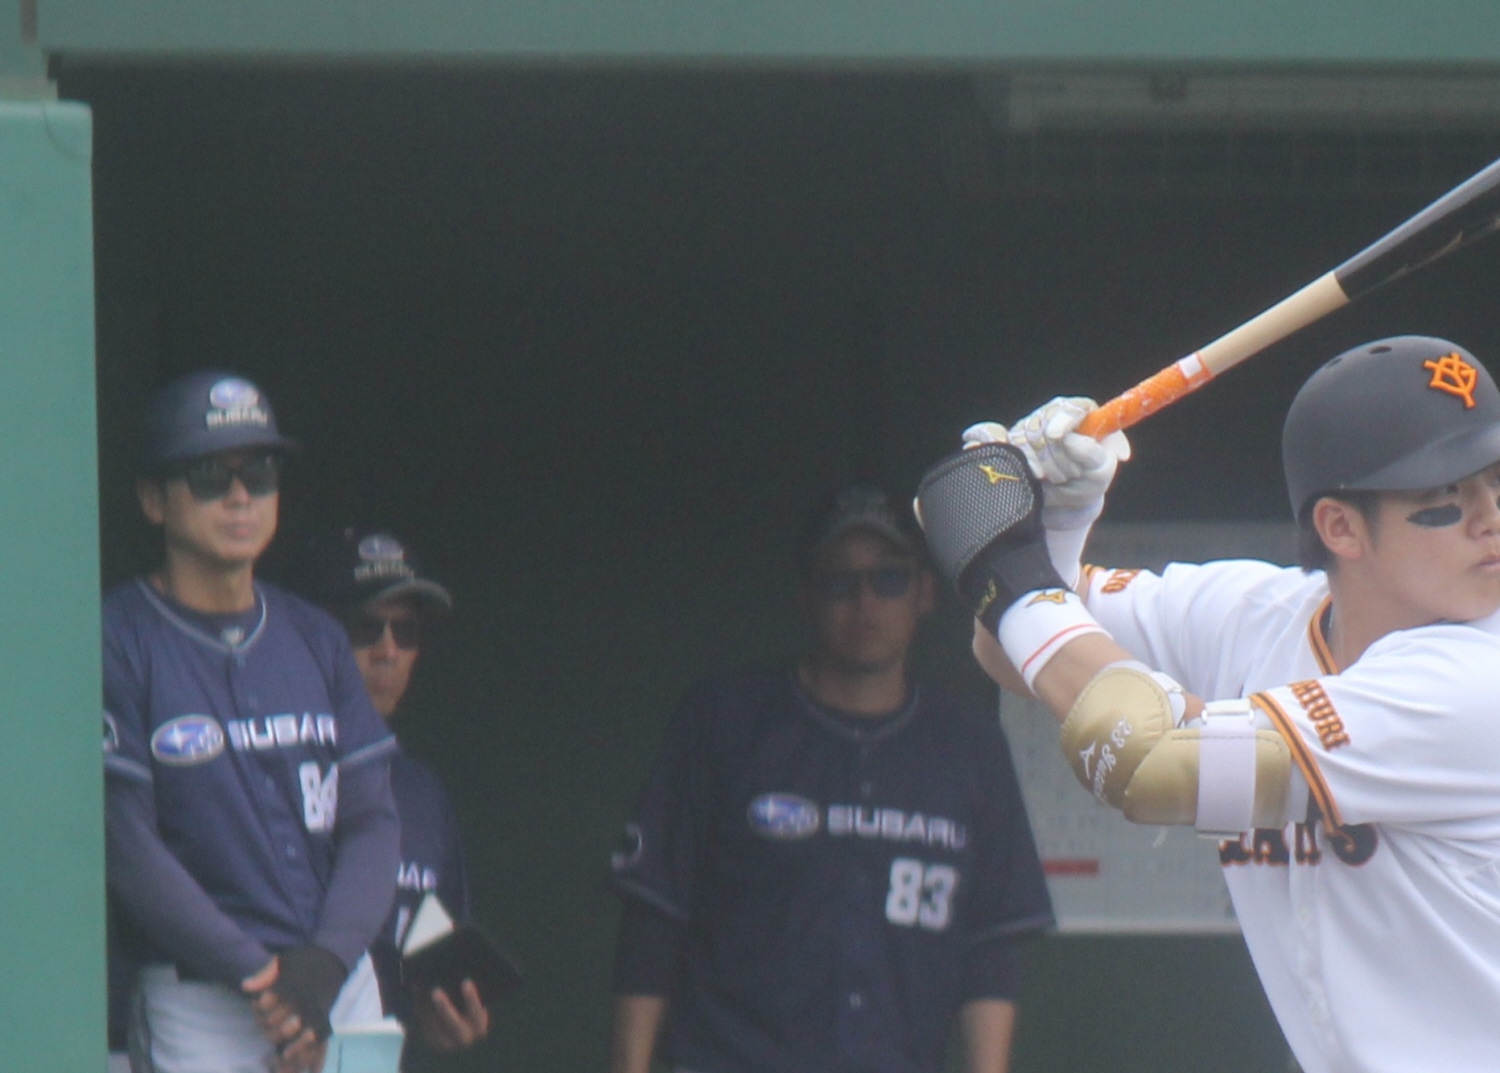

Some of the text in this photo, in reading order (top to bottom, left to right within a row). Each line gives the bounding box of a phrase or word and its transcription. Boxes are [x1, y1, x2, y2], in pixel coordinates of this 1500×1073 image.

[228, 712, 337, 751] SUBAR
[827, 804, 967, 850] SUBARU
[885, 858, 958, 932] 83
